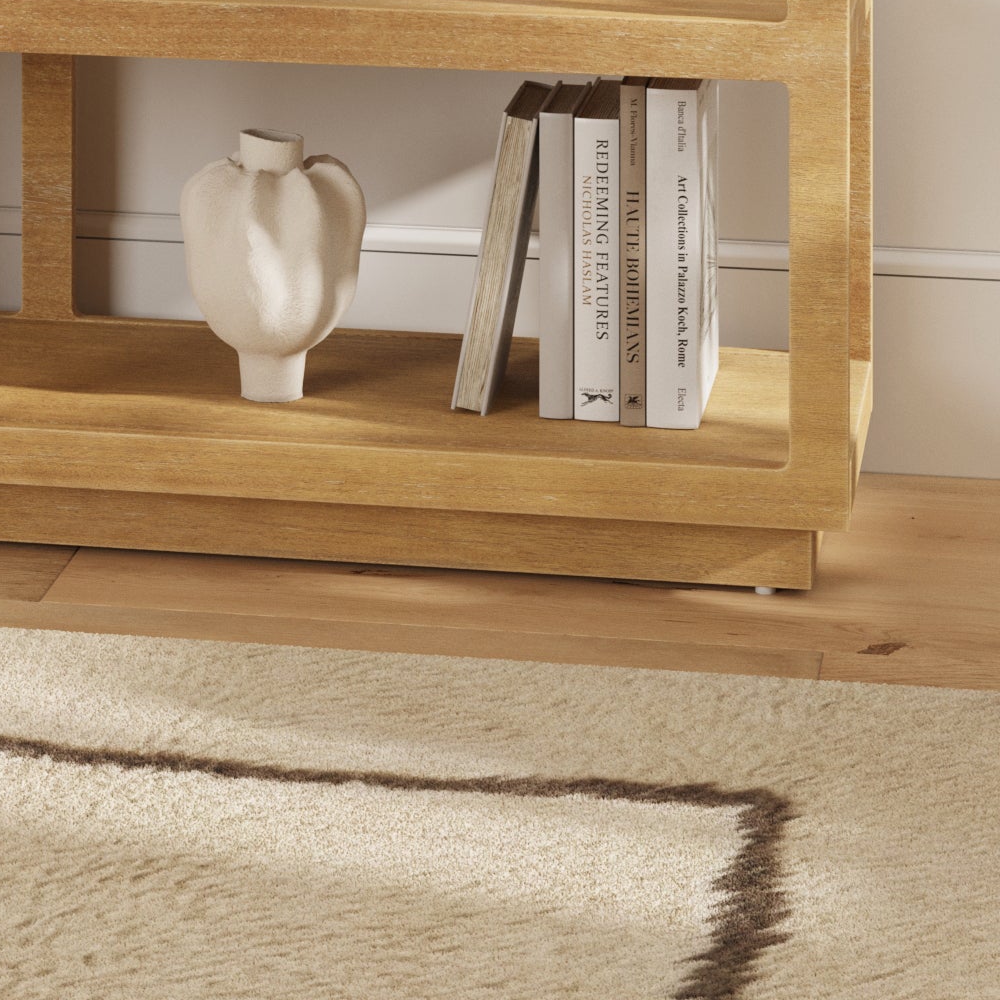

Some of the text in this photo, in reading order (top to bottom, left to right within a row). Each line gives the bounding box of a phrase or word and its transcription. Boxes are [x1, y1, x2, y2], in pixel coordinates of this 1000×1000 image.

[677, 101, 687, 152] Banca d'Italia
[582, 175, 592, 306] NICHOLAS HASLAM
[595, 139, 609, 340] REDEEMING FEATURES
[626, 191, 639, 363] HAUTE BOHEMIANS
[676, 175, 689, 368] Art Collections in Palazzo Koch, Rome
[677, 388, 687, 412] Electa
